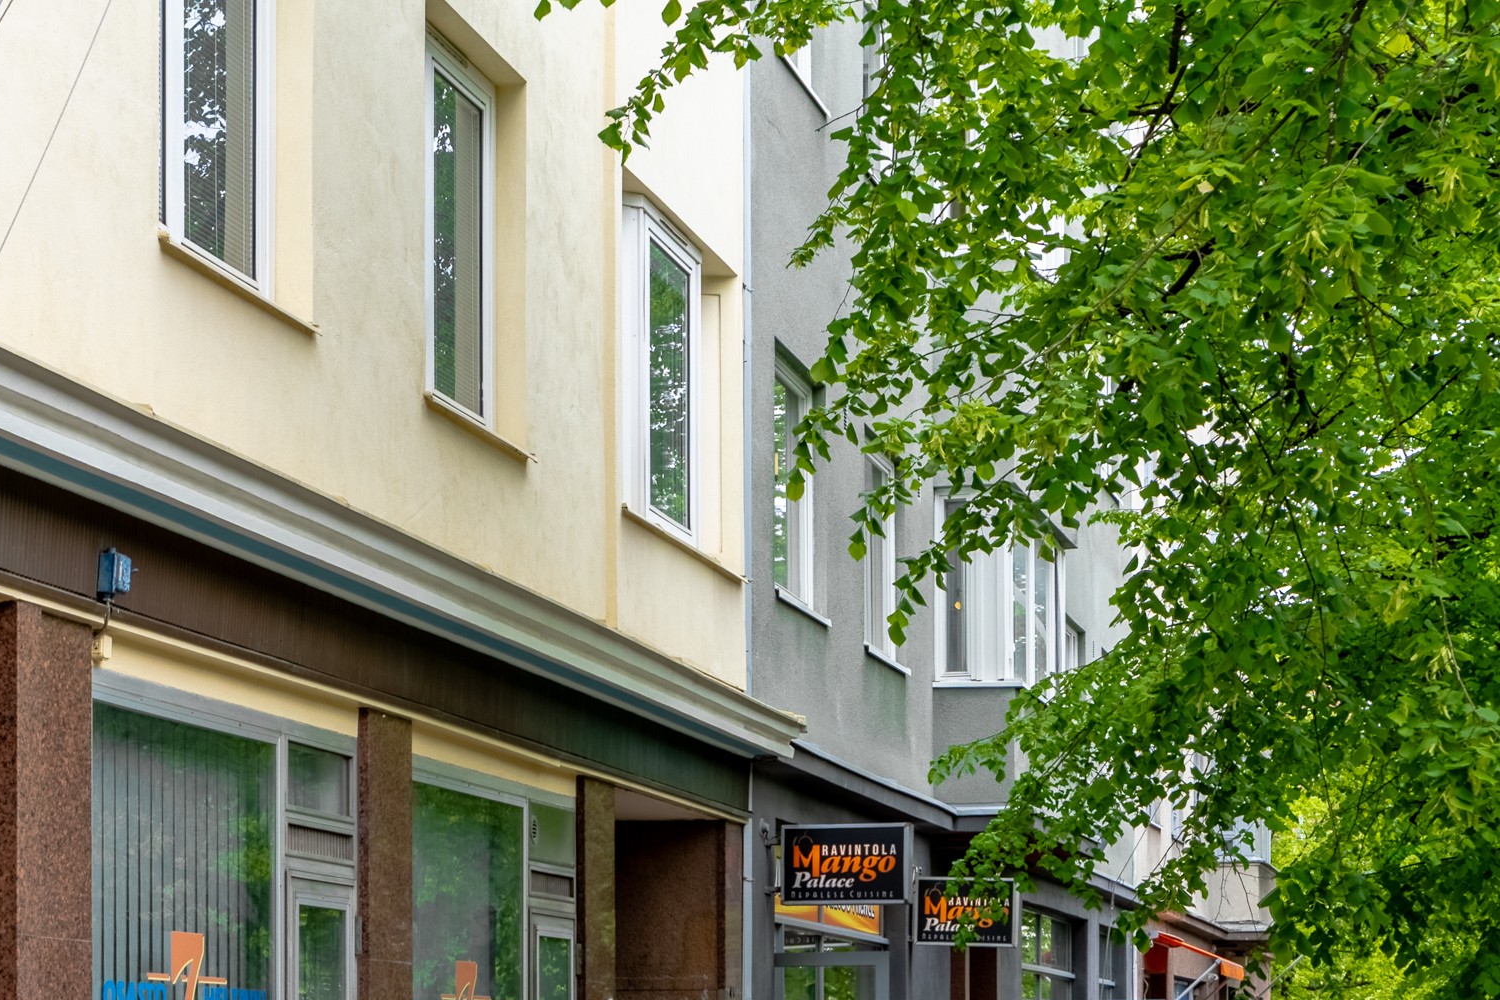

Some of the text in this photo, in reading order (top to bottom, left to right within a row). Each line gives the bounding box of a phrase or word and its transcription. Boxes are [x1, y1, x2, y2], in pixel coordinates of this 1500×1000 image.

[822, 843, 897, 856] RAVINTOLA
[793, 844, 897, 882] Mango
[792, 871, 854, 889] Palace
[923, 917, 975, 932] Palae
